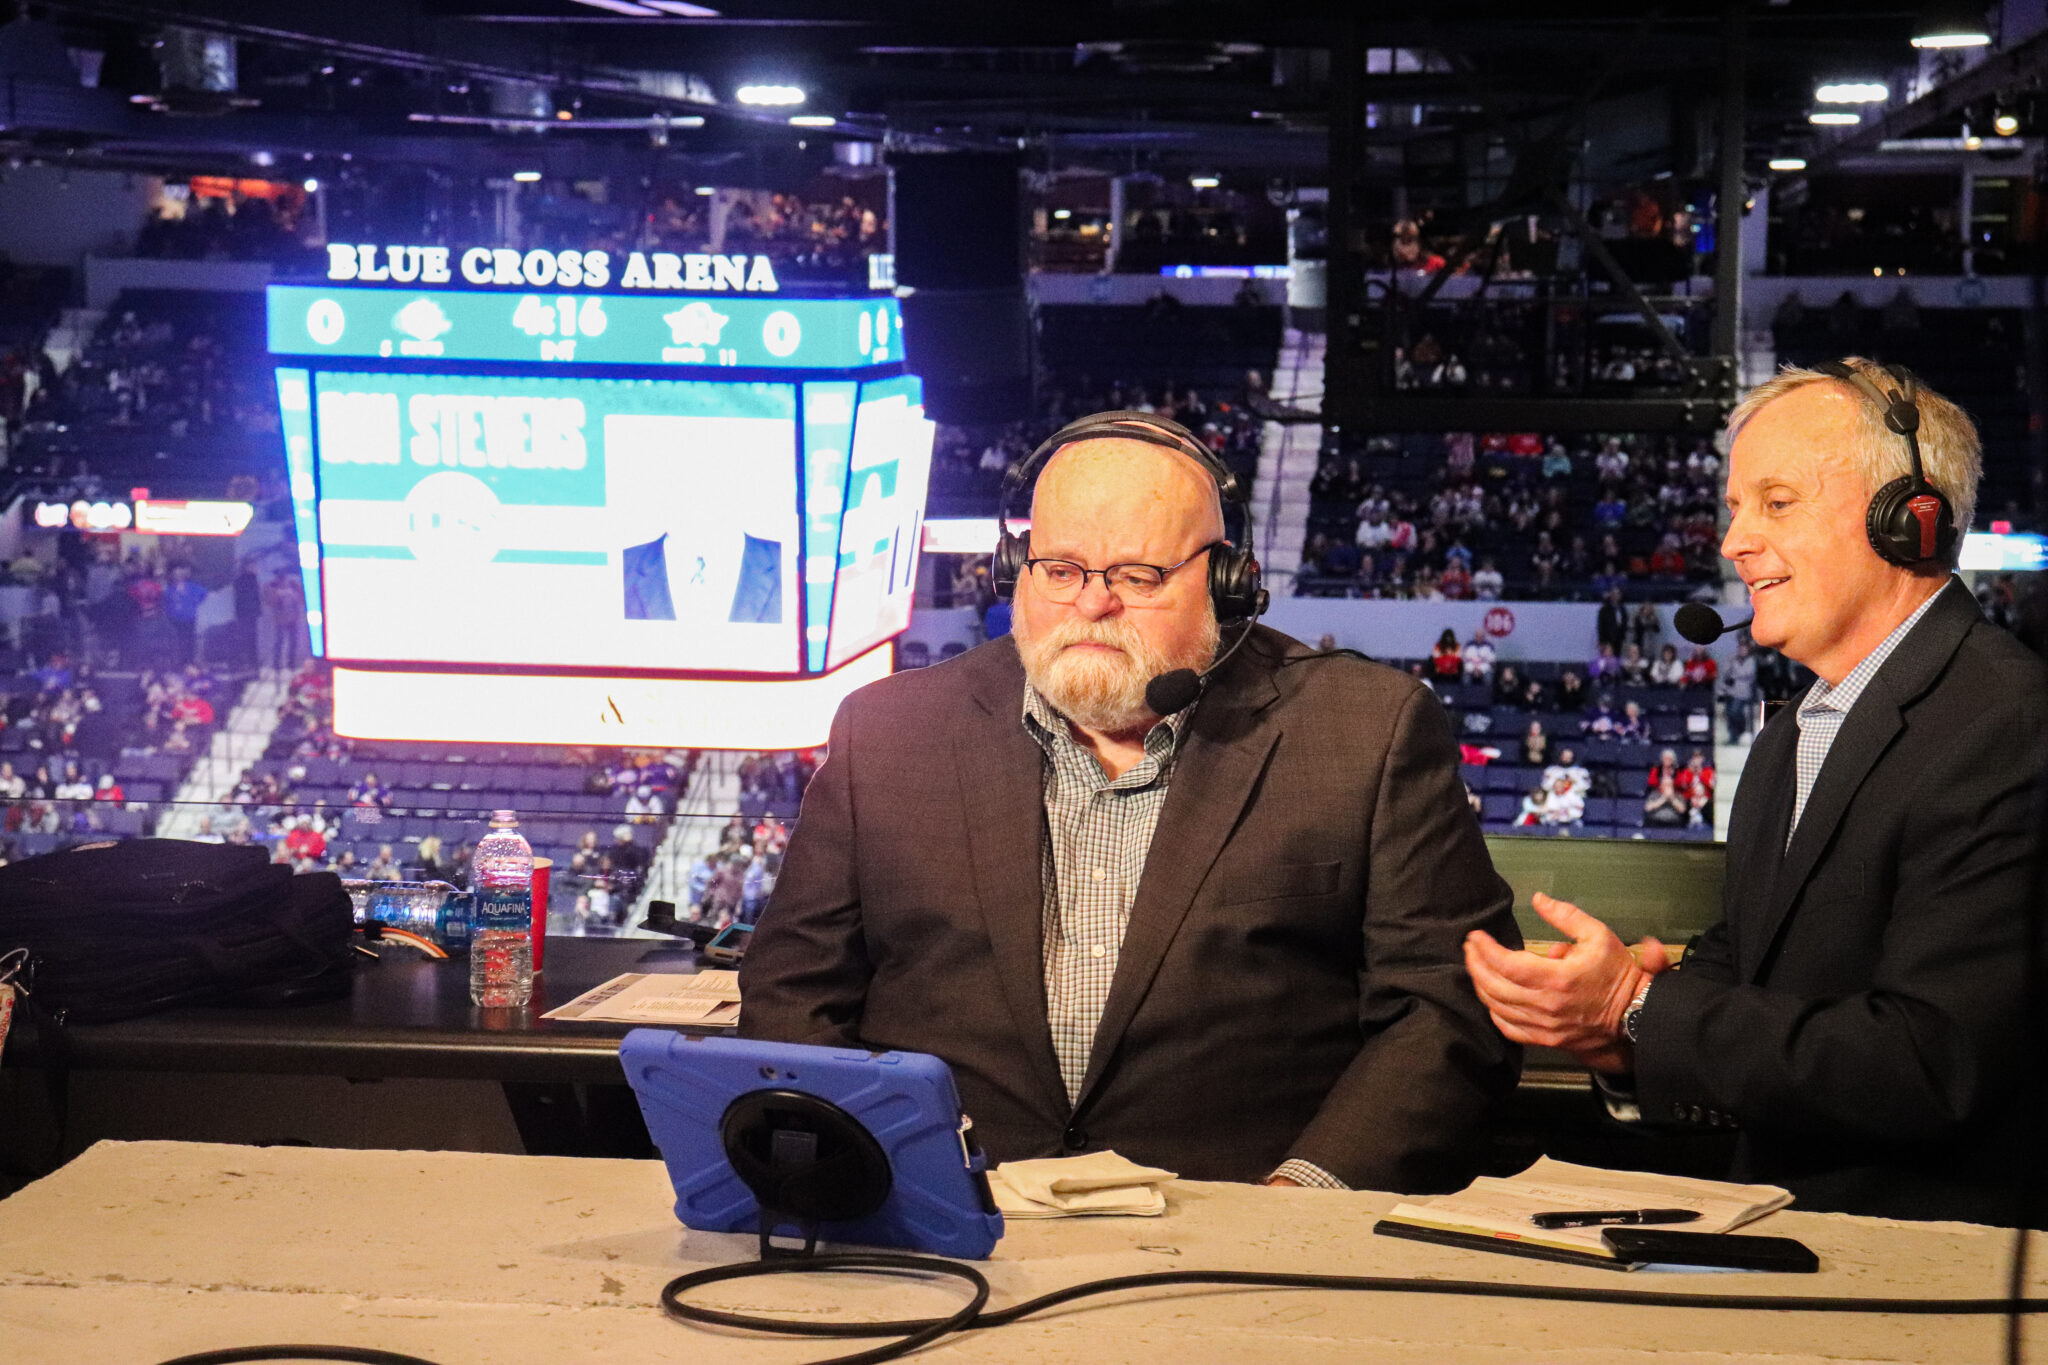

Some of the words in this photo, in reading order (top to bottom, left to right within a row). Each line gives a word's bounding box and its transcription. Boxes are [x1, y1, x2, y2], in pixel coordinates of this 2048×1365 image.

[327, 243, 450, 282] BLUE
[461, 247, 611, 286] CROSS
[621, 252, 779, 292] ARENA
[307, 299, 345, 345] 0
[512, 295, 607, 336] 4:16
[763, 310, 800, 357] 0
[482, 901, 528, 916] AQUAFINA
